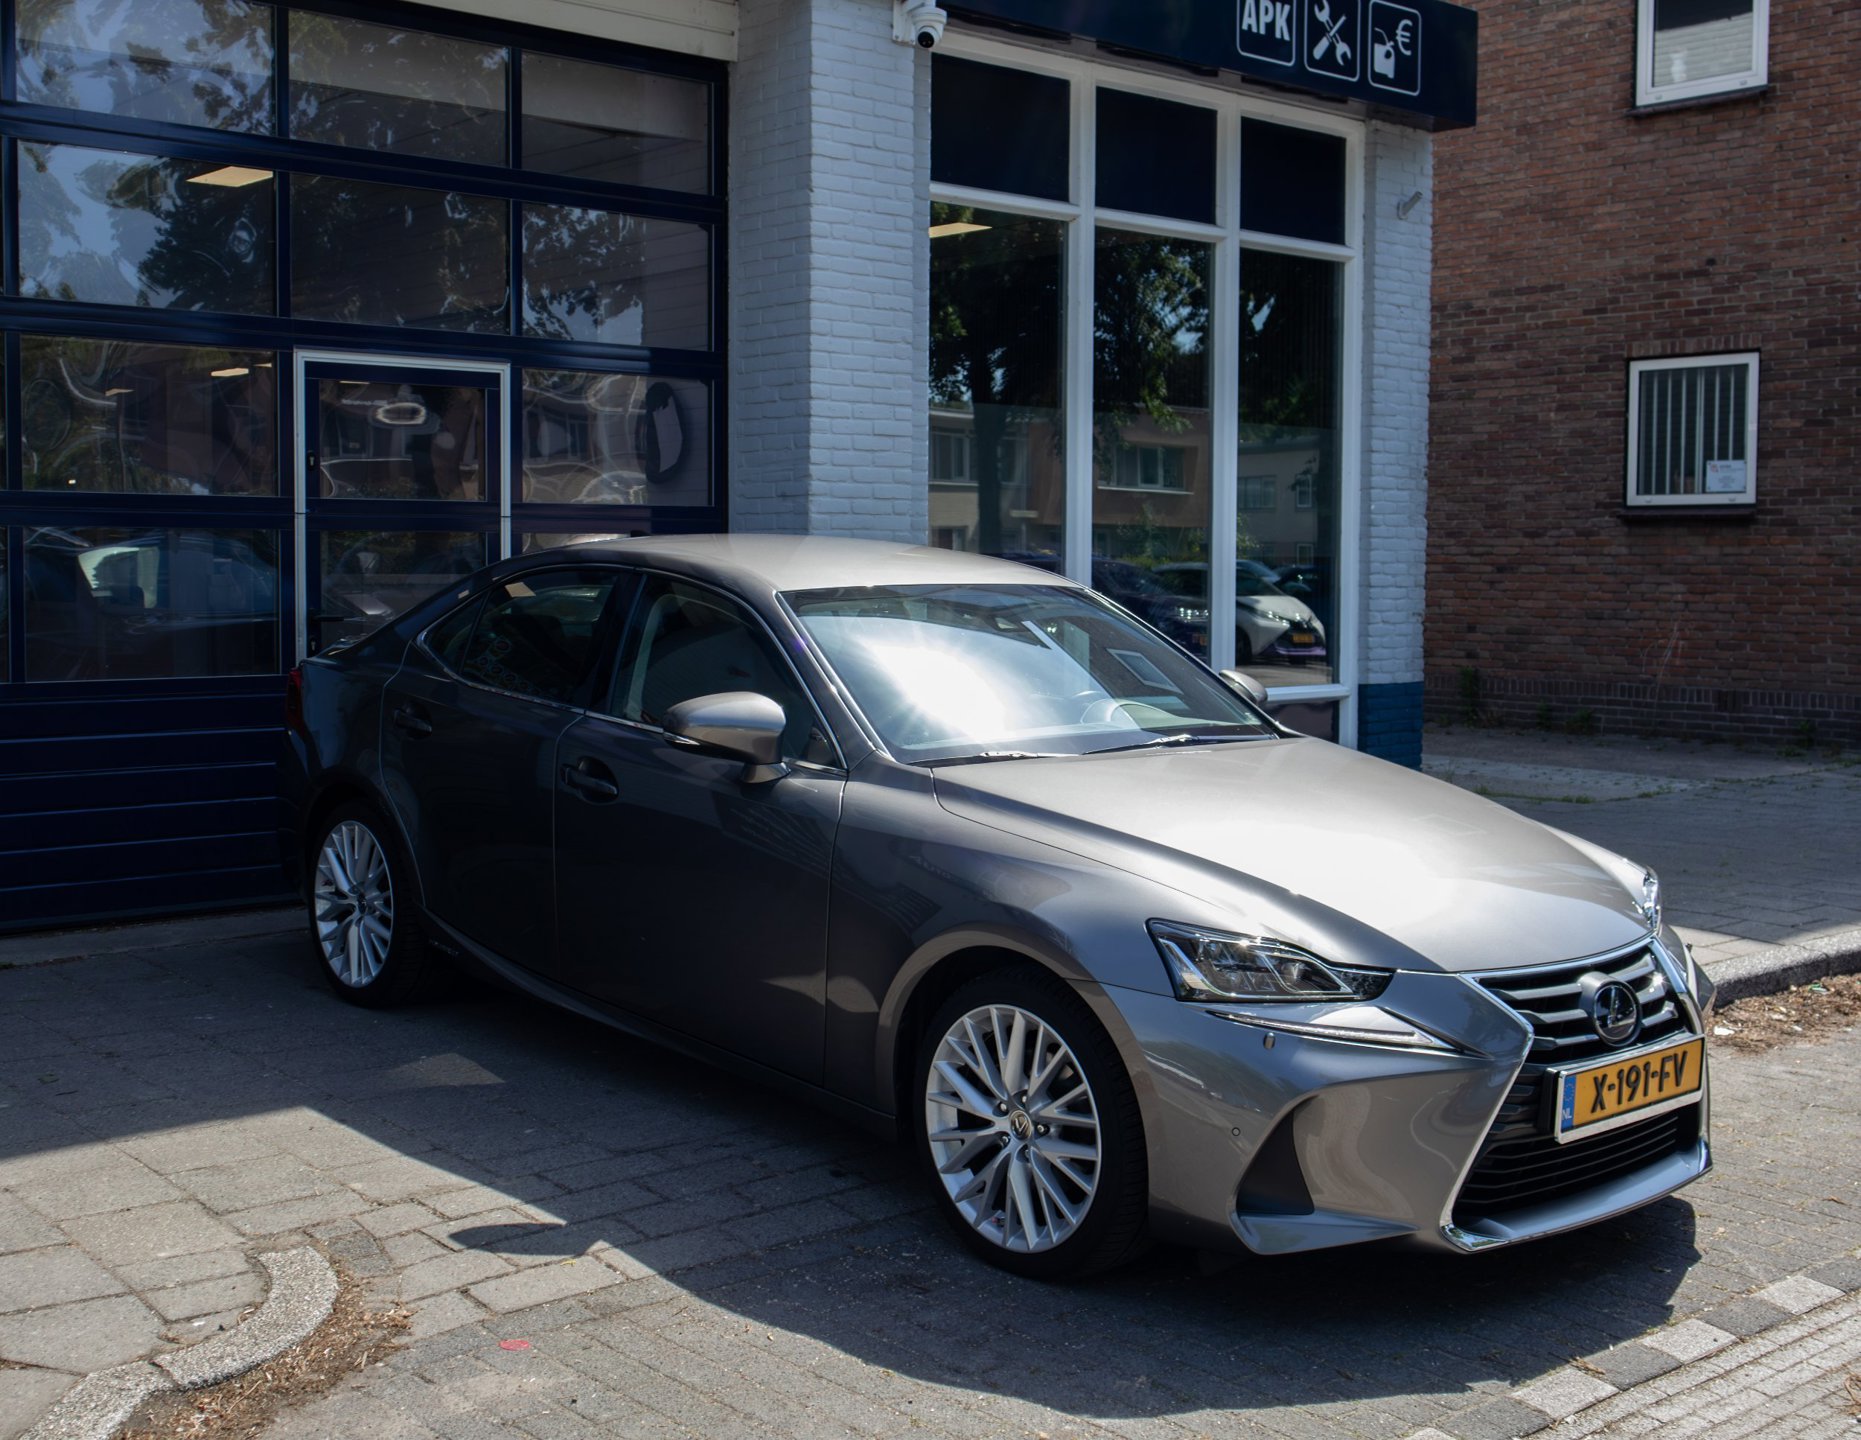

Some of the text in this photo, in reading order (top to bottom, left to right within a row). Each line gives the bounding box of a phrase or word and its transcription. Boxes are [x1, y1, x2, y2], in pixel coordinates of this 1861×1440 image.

[1241, 0, 1291, 41] APK
[1562, 1051, 1688, 1120] NL X-191-FV
